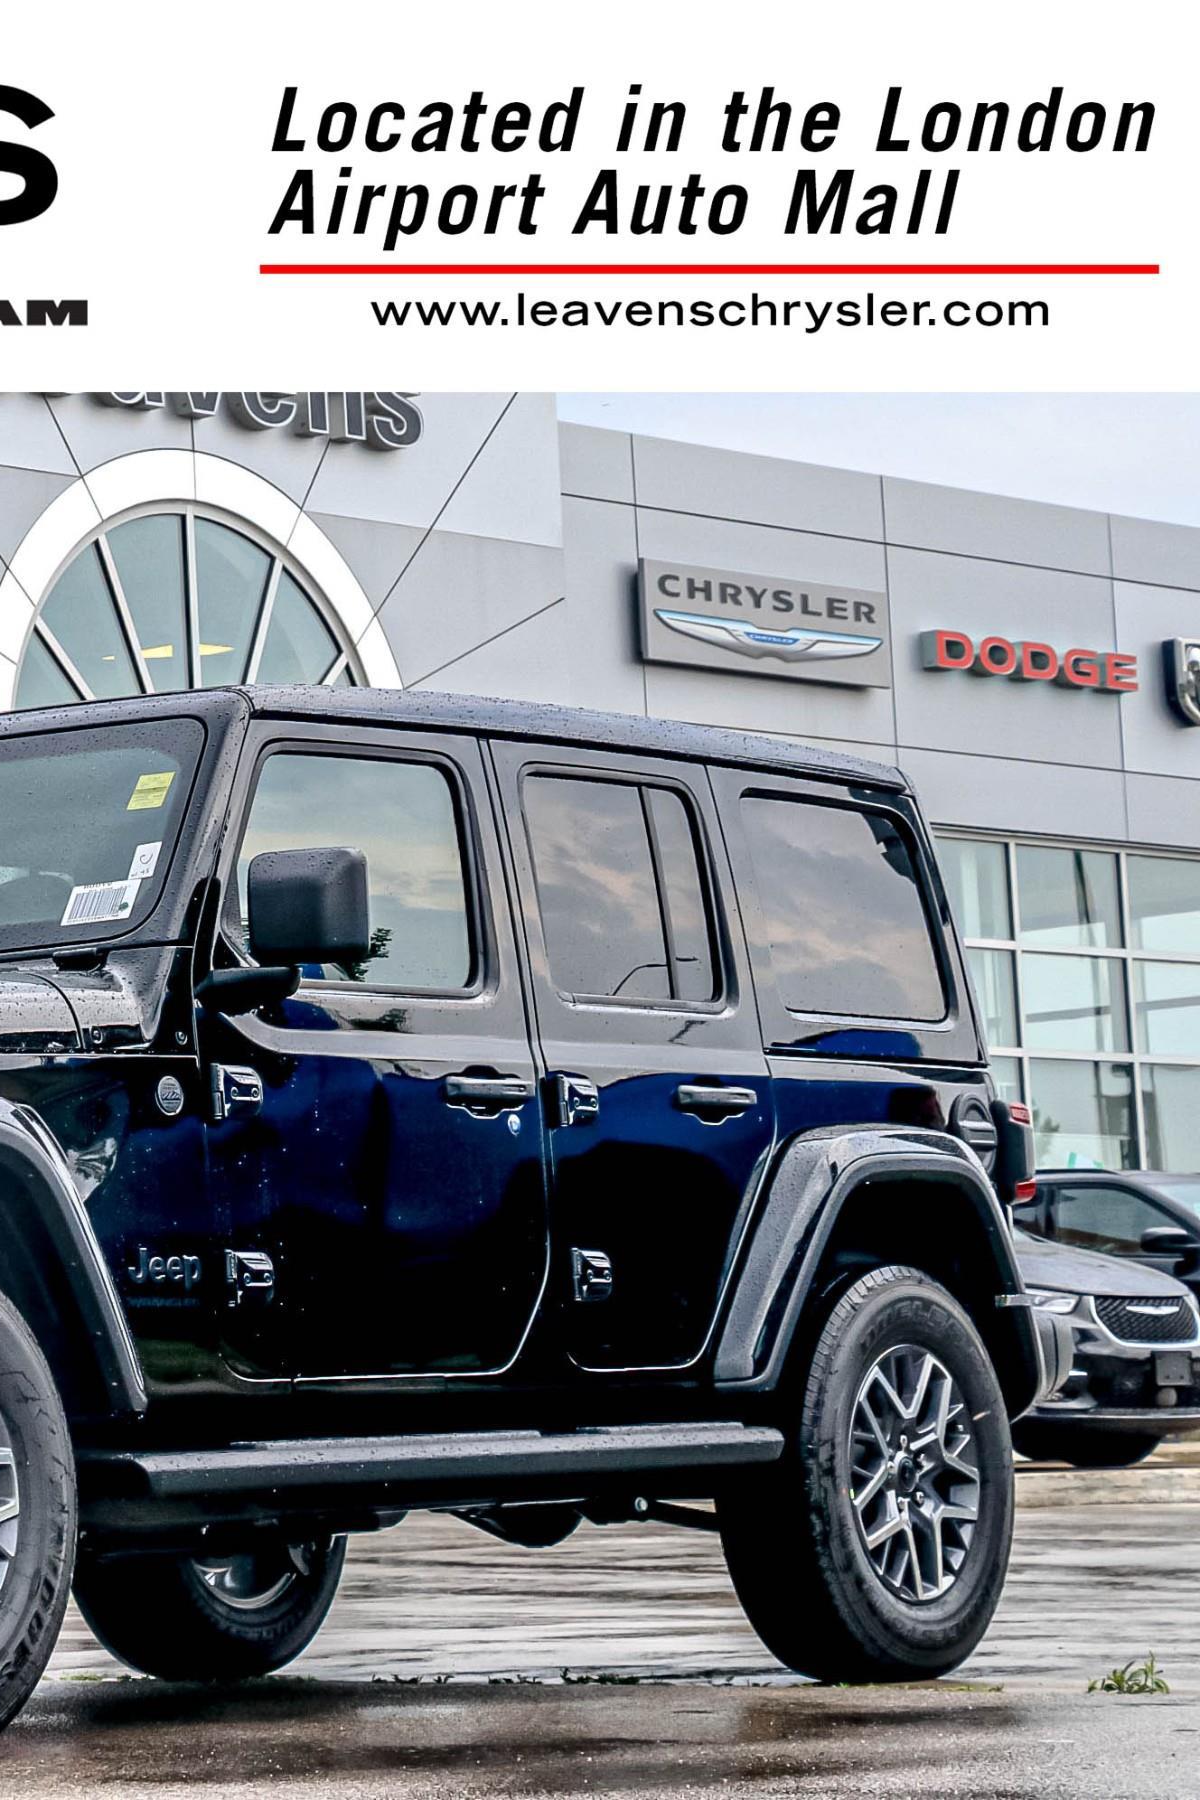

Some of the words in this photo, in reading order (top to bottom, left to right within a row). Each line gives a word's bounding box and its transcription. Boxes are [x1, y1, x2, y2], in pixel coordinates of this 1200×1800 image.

[657, 574, 876, 624] CHRYSLER
[930, 629, 1138, 691] DODGE
[127, 1247, 202, 1292] Jeep
